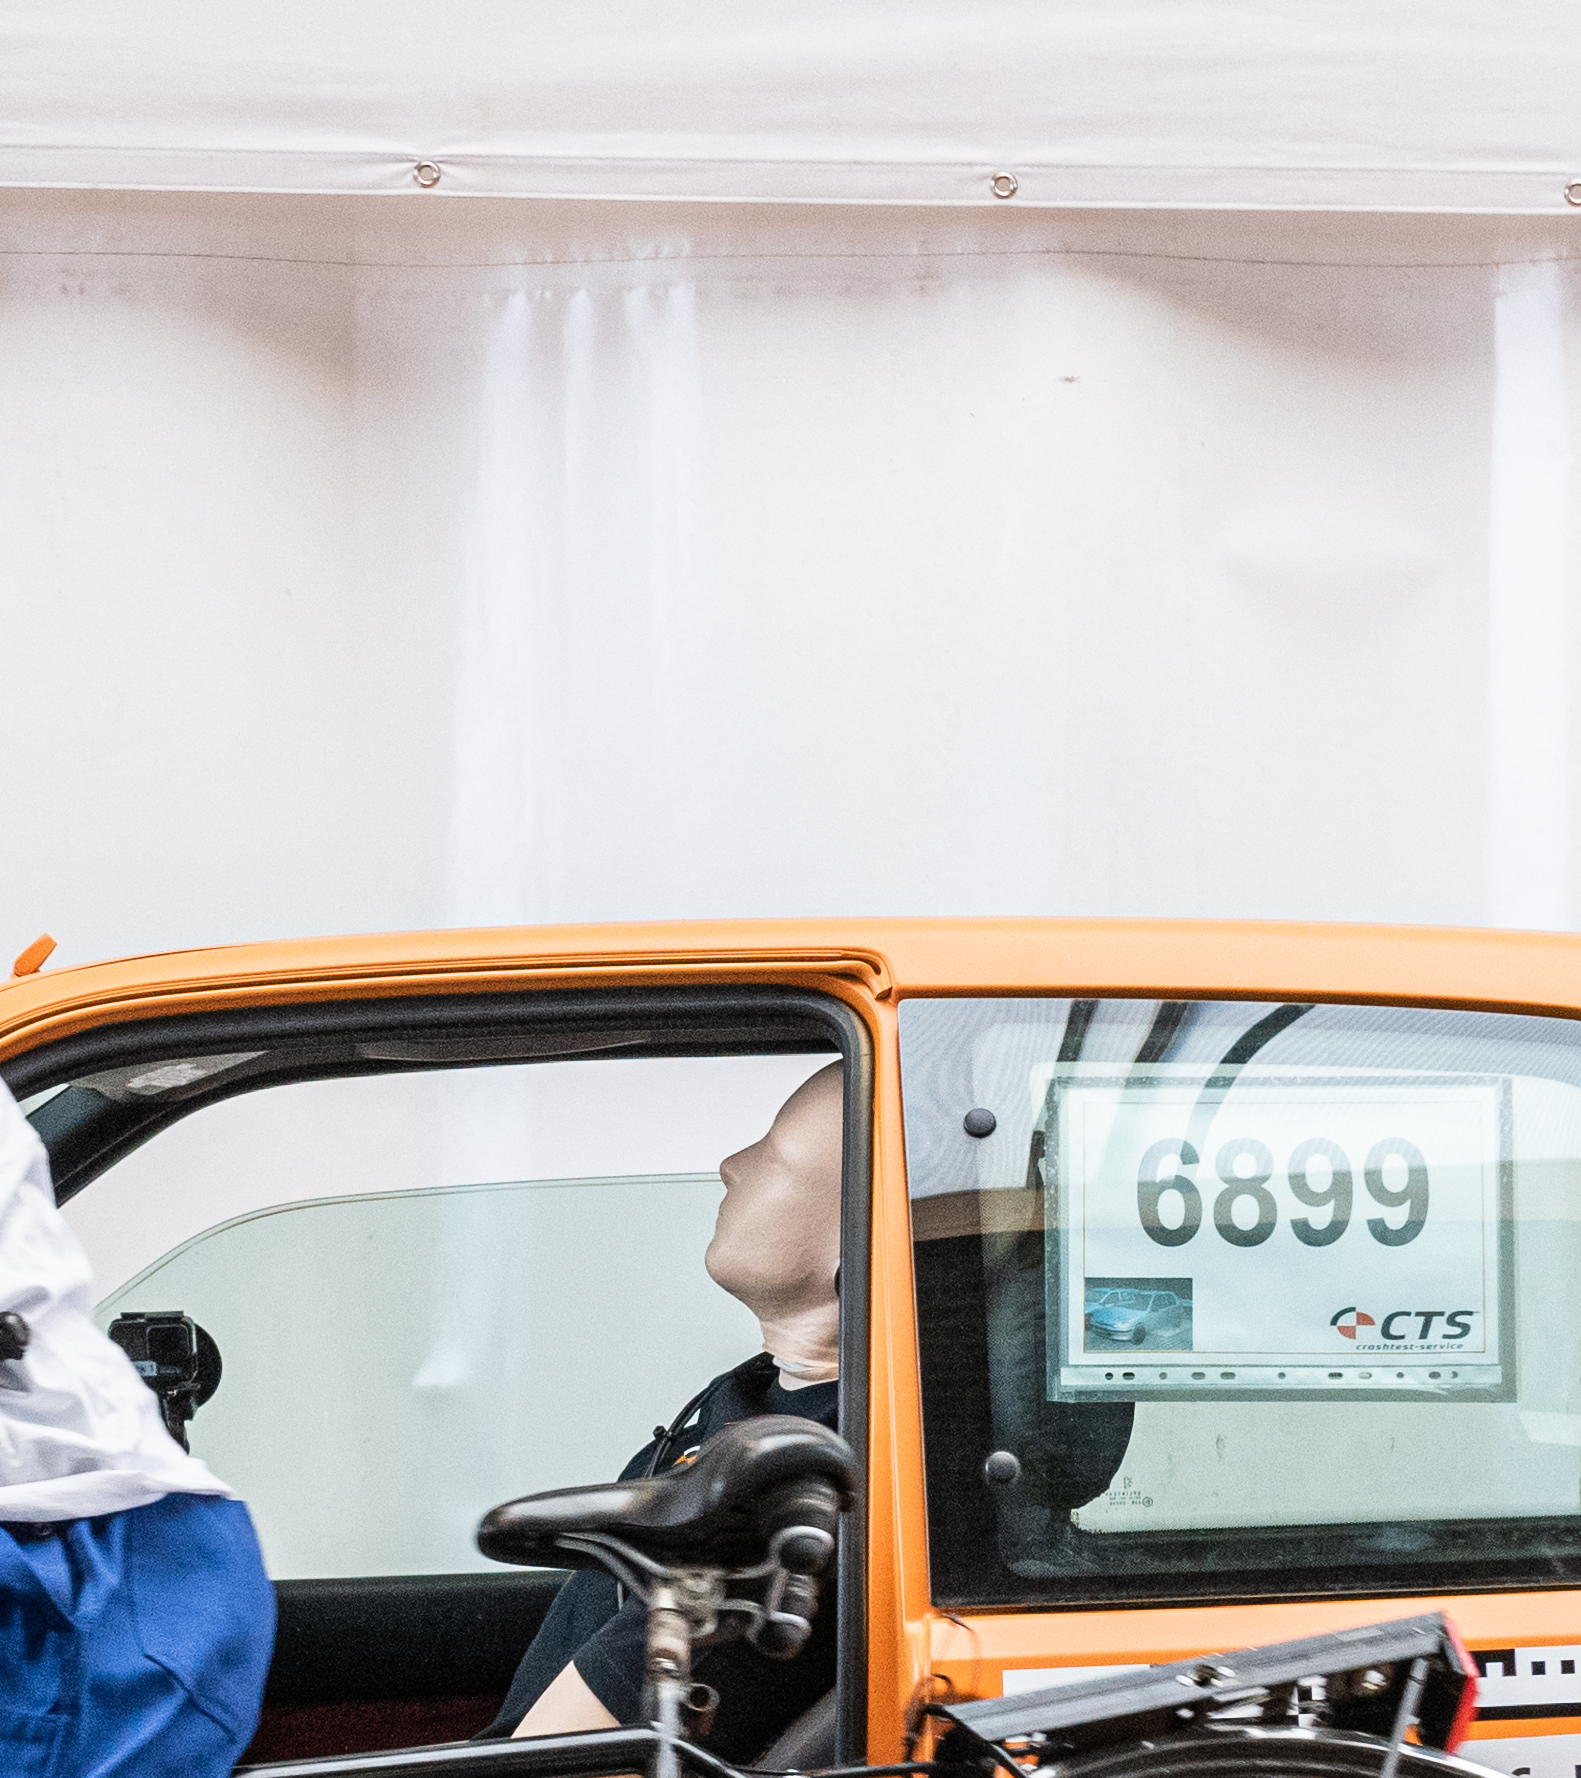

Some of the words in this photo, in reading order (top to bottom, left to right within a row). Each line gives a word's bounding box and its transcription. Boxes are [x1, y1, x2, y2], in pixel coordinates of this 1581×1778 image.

[1137, 1136, 1431, 1248] 6899
[1379, 1309, 1475, 1341] CTS
[1355, 1342, 1465, 1351] crashtest-service
